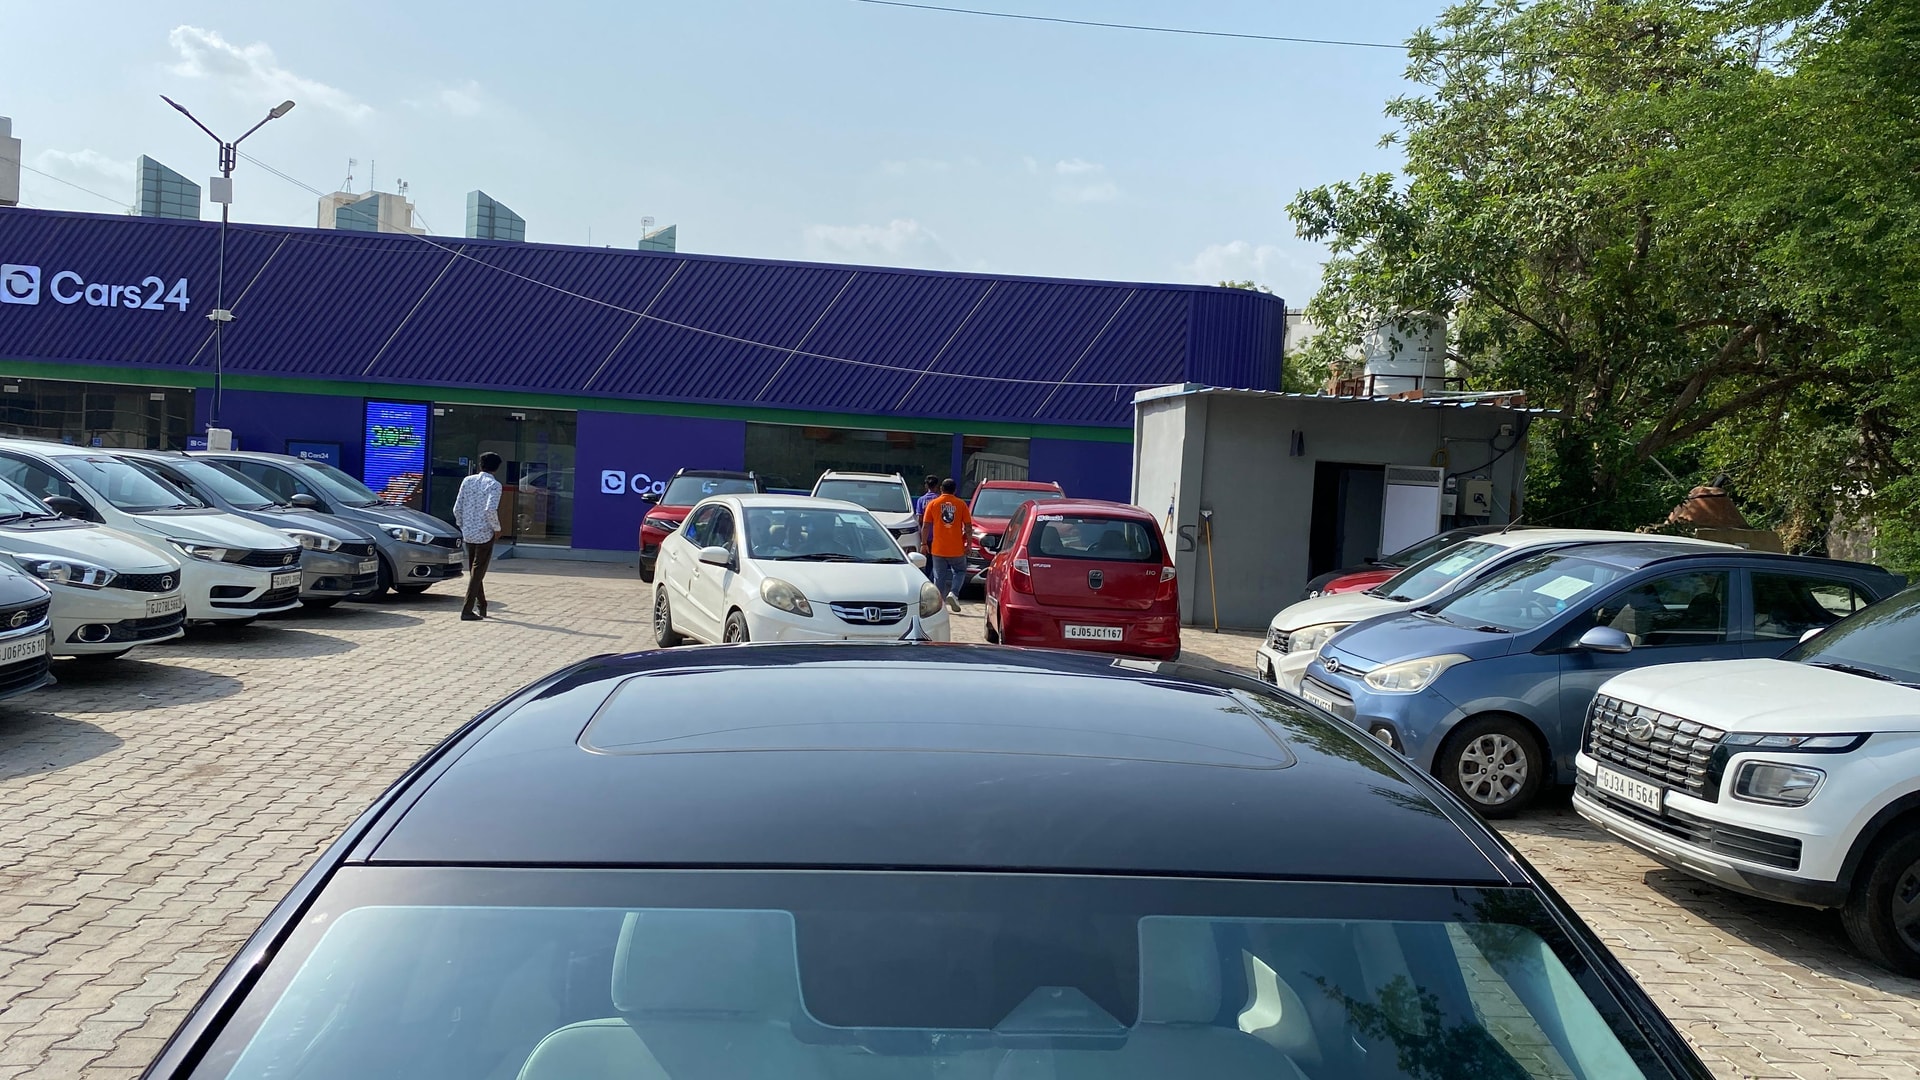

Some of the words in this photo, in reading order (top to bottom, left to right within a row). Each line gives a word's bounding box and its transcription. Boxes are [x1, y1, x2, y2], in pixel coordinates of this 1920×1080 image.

[50, 270, 190, 312] Cars24
[1071, 625, 1122, 638] GJ05JC1167
[0, 638, 45, 661] J06PS5610
[1603, 771, 1624, 794] GJ34
[1627, 781, 1634, 798] H
[1636, 784, 1659, 808] 5641
